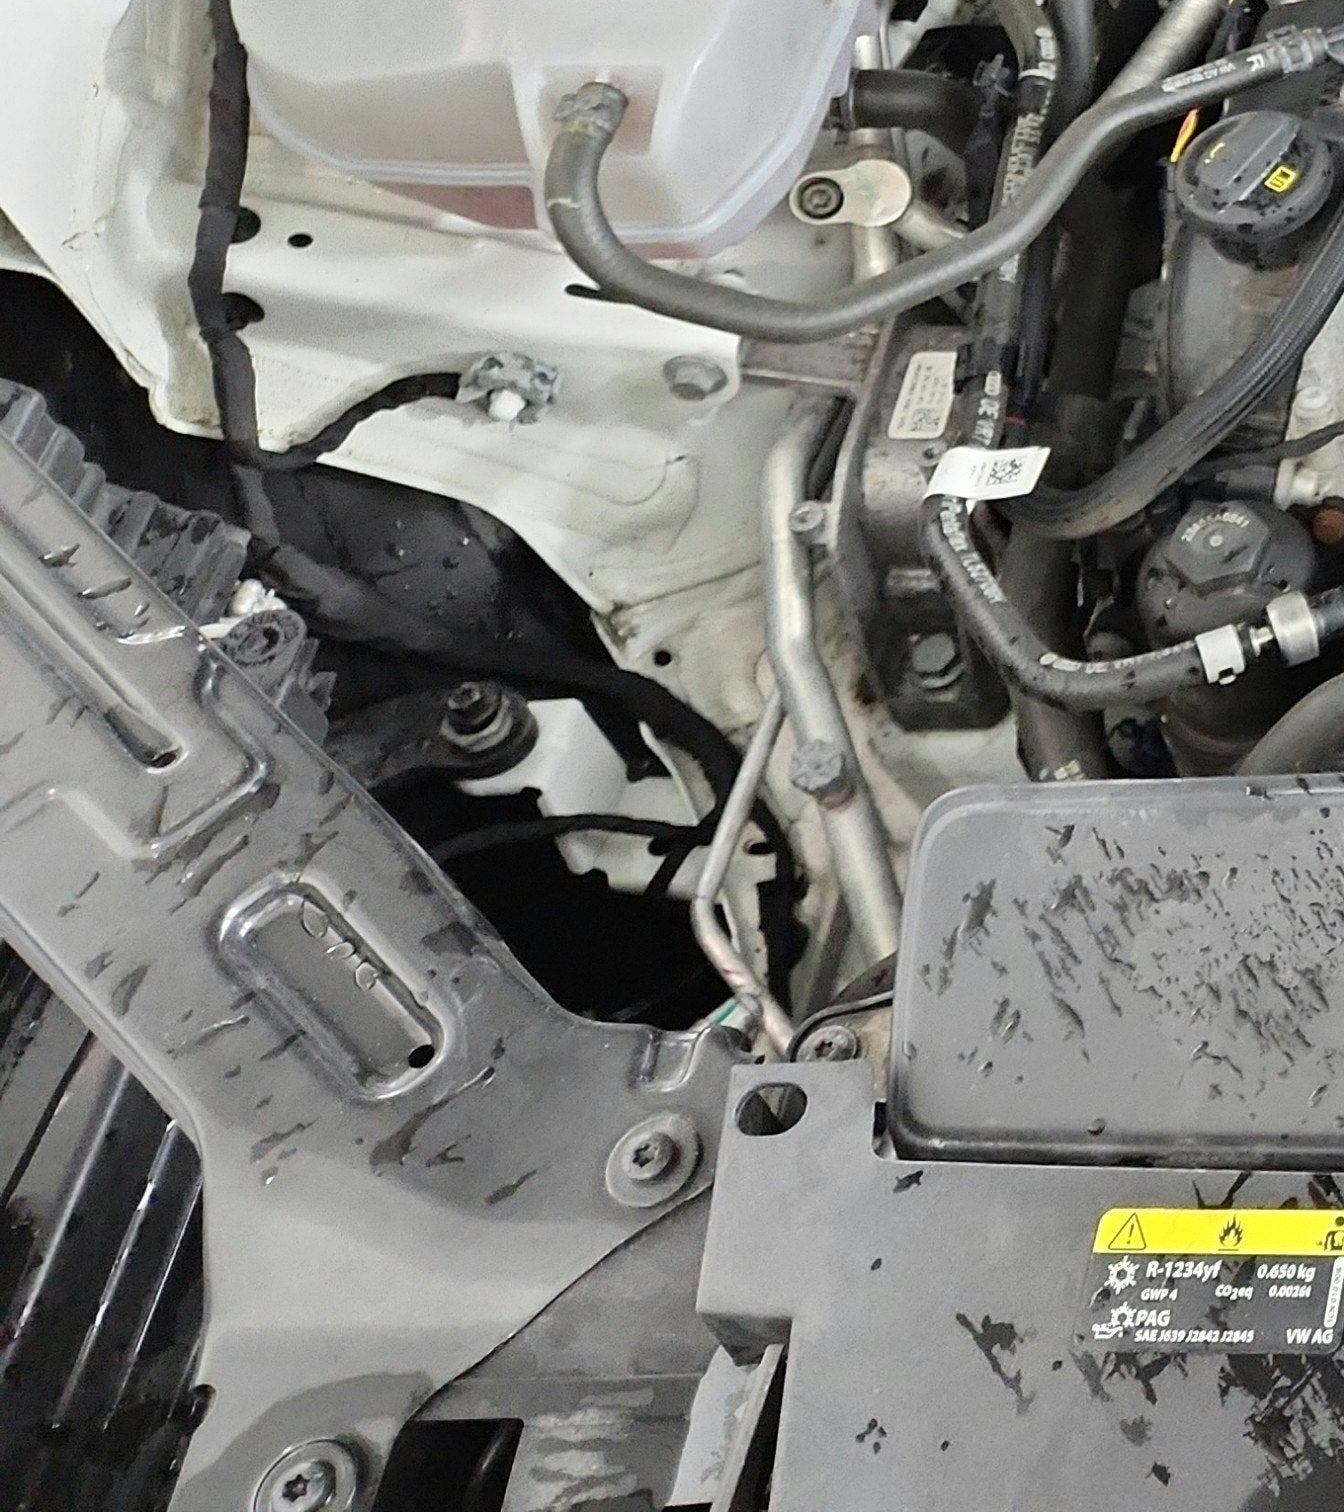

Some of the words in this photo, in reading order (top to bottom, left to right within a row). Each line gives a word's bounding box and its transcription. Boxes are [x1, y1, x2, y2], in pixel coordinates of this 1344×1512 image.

[1145, 1259, 1223, 1282] R-1234yf
[1296, 1263, 1317, 1283] kg
[1140, 1287, 1169, 1301] GWP
[1168, 1288, 1178, 1301] 4
[1134, 1309, 1171, 1327] PAG
[1133, 1328, 1159, 1343] SAE
[1286, 1328, 1313, 1344] VW
[1310, 1328, 1334, 1345] AG
